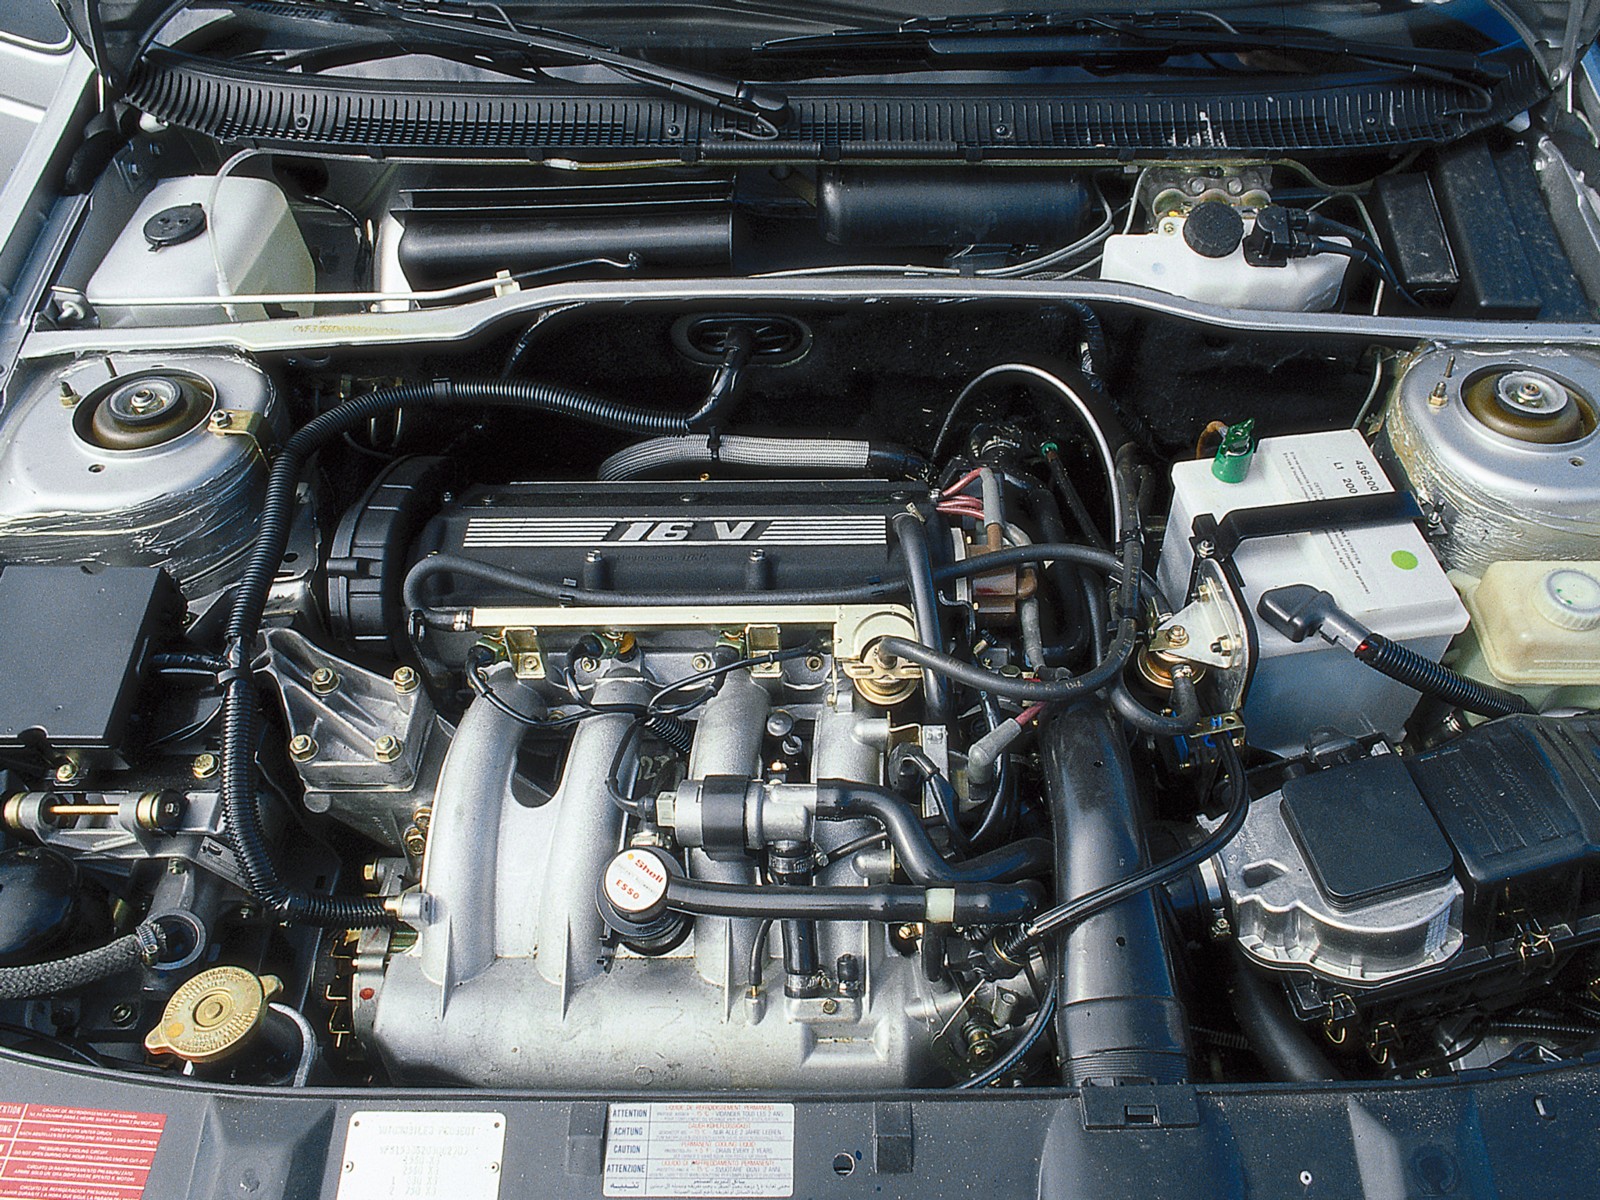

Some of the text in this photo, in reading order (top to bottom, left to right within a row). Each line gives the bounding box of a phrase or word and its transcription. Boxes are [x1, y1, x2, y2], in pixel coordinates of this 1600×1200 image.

[1355, 459, 1380, 492] 436200
[1342, 477, 1358, 494] 200
[618, 521, 756, 541] 16 V
[634, 859, 664, 883] Shell
[615, 879, 640, 900] ESSO
[612, 1109, 648, 1118] ATTENTION
[614, 1127, 643, 1136] ACHTUNG
[614, 1145, 641, 1154] CAUTION
[606, 1164, 645, 1173] ATTENZIONE
